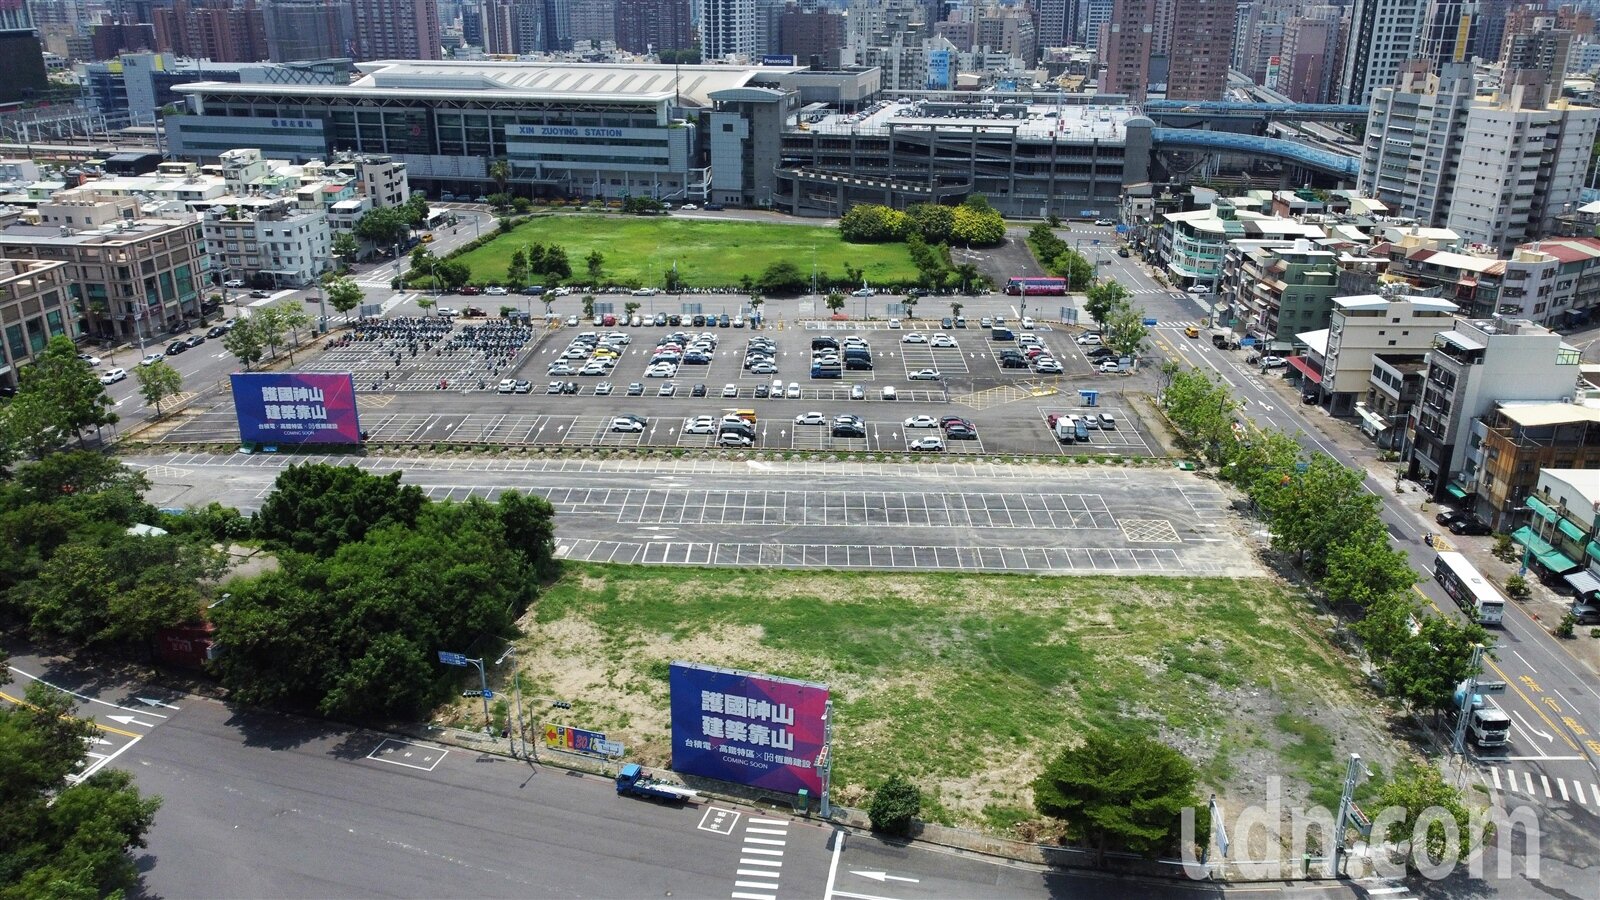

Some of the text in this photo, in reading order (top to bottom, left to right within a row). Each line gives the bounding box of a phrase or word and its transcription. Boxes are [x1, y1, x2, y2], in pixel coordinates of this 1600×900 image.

[519, 126, 622, 137] XIN ZUOYING STATION
[261, 386, 324, 402] 護國神山
[264, 404, 327, 420] 建築靠山
[701, 690, 794, 726] 護國神山
[702, 715, 794, 751] 建築靠山
[685, 738, 711, 751] 台積電
[723, 756, 768, 770] COMING SOON
